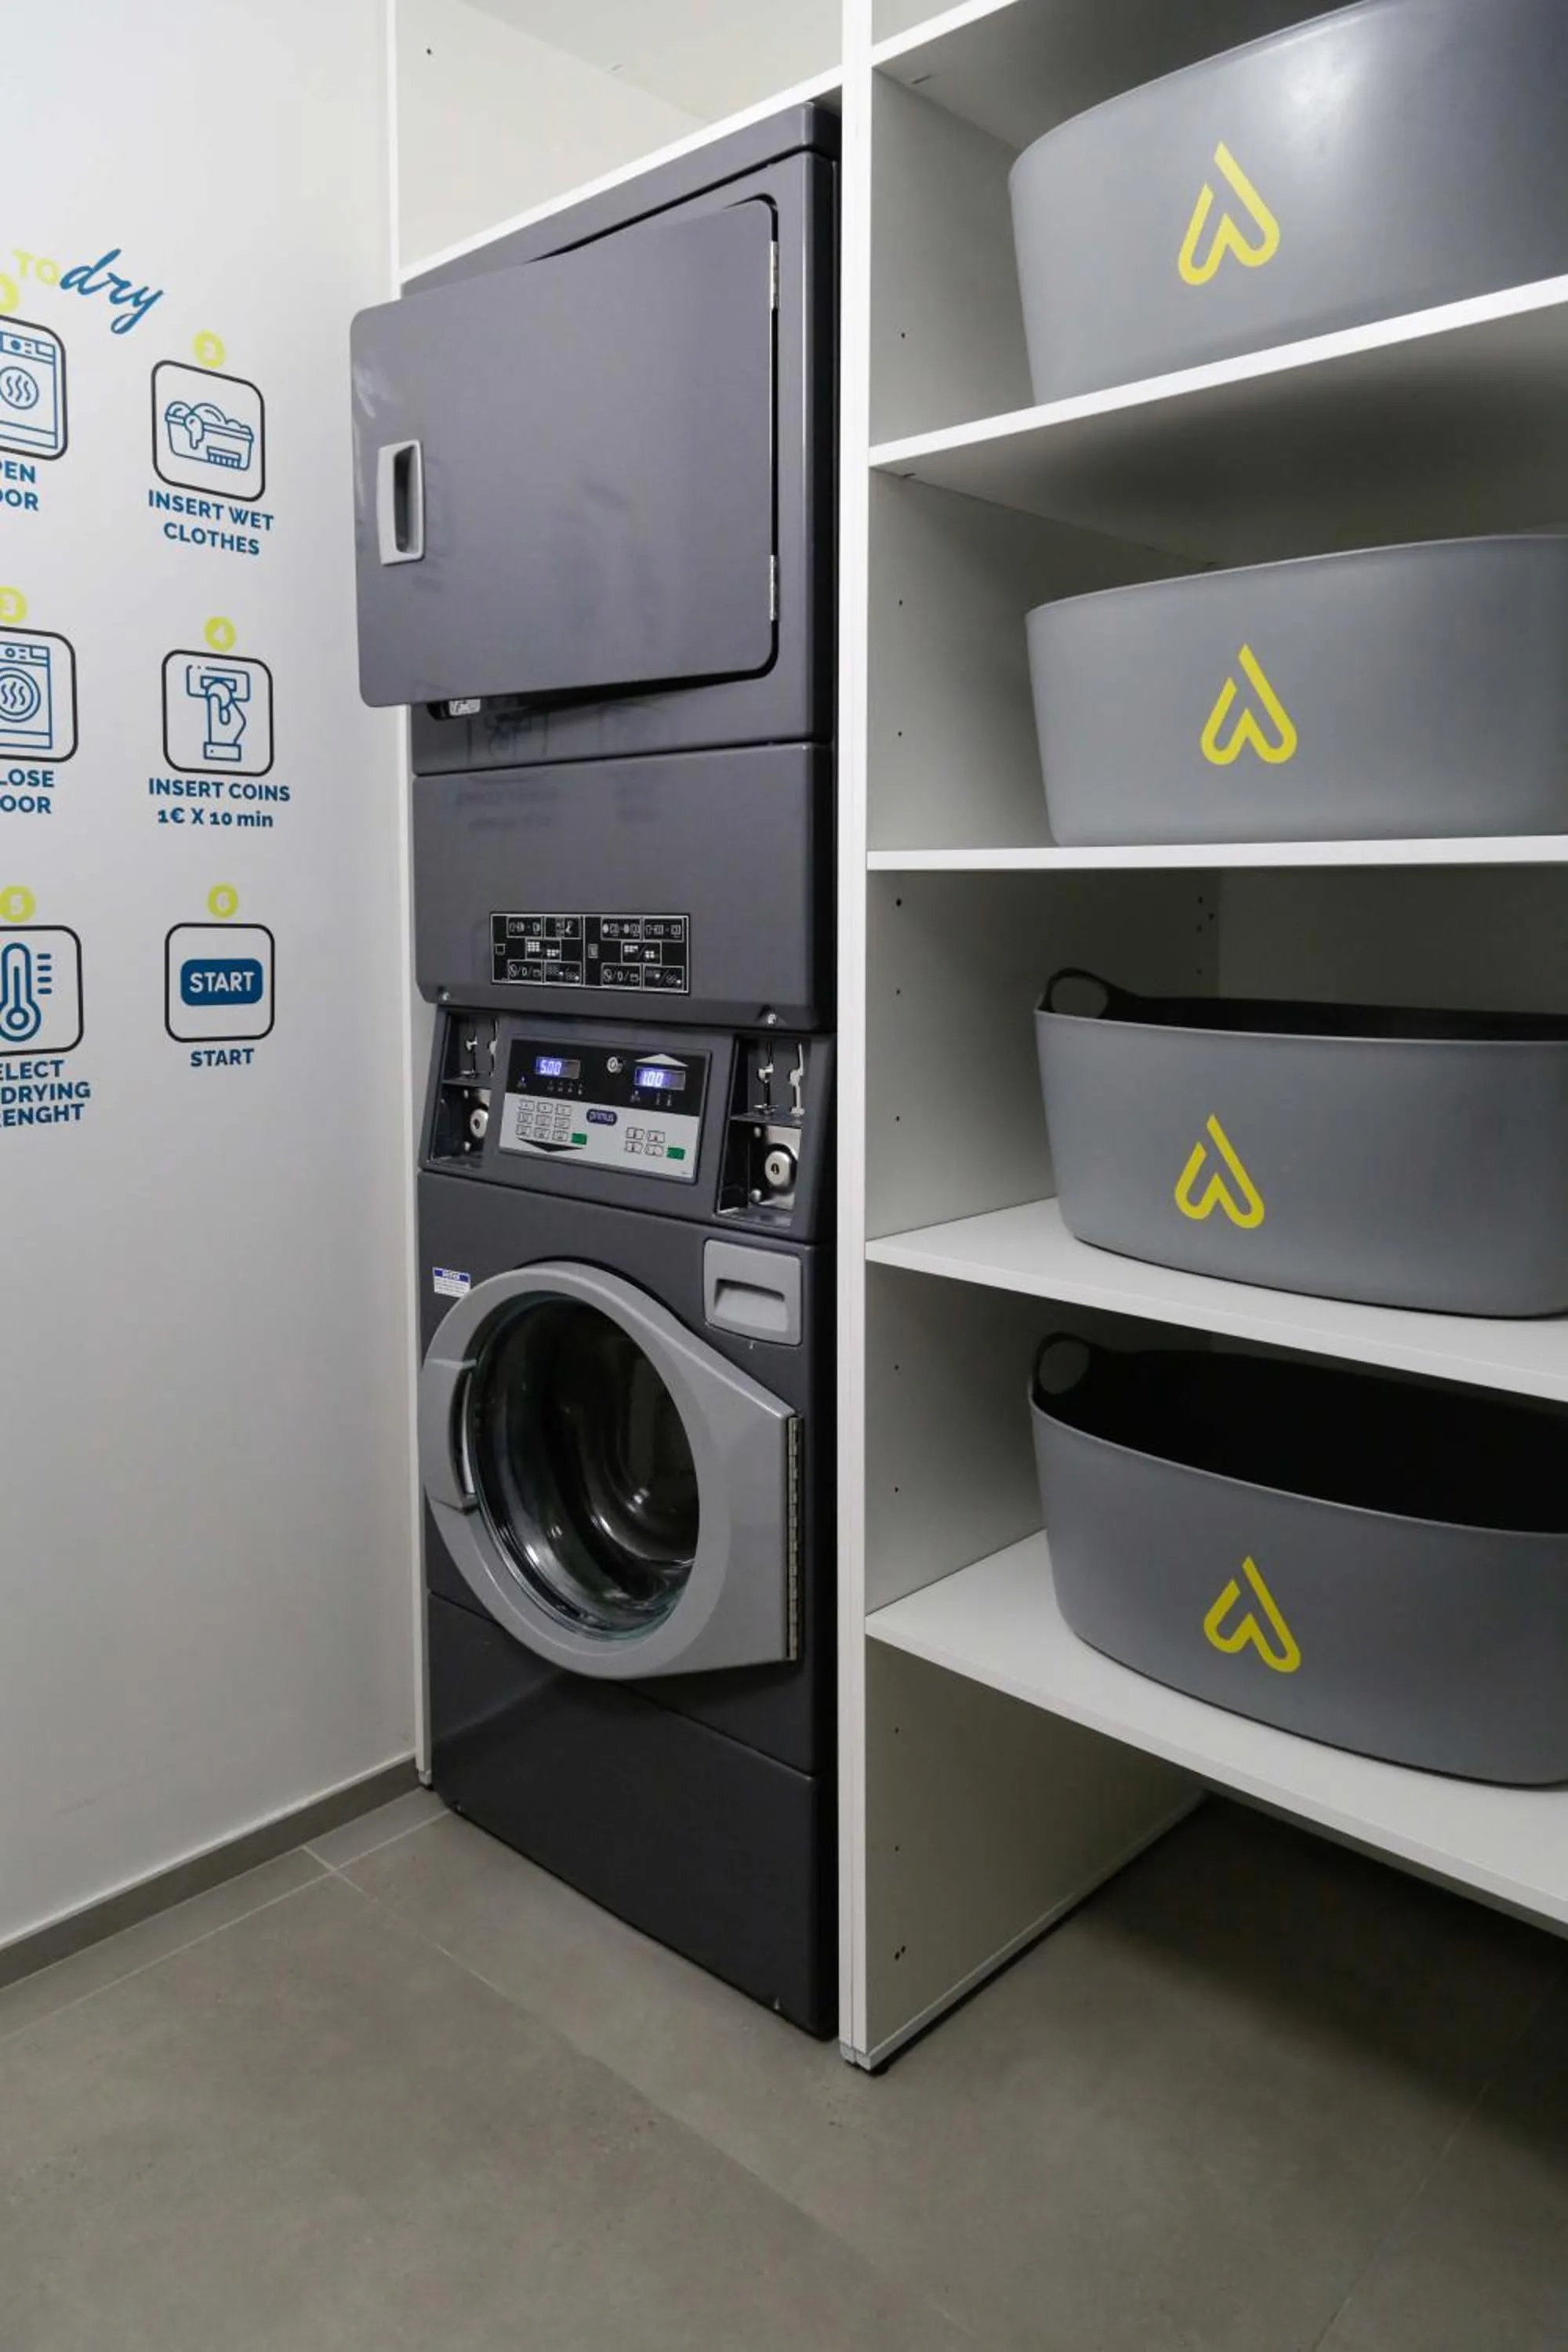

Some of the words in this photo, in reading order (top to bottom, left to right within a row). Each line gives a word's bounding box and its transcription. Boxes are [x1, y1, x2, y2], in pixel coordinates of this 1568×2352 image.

[13, 249, 59, 287] TO
[60, 249, 163, 334] dry
[0, 460, 35, 484] EN
[0, 489, 38, 511] OR
[149, 489, 224, 521] INSERT
[229, 506, 274, 531] WET
[163, 522, 260, 555] CLOTHES
[149, 778, 224, 798] INSERT
[229, 784, 291, 802] COINS
[158, 808, 185, 824] 1€
[210, 811, 232, 826] 10
[238, 811, 274, 827] min
[189, 971, 254, 993] START
[191, 1048, 255, 1067] START
[1, 1081, 91, 1105] DRYING
[0, 1103, 85, 1127] ENGHT
